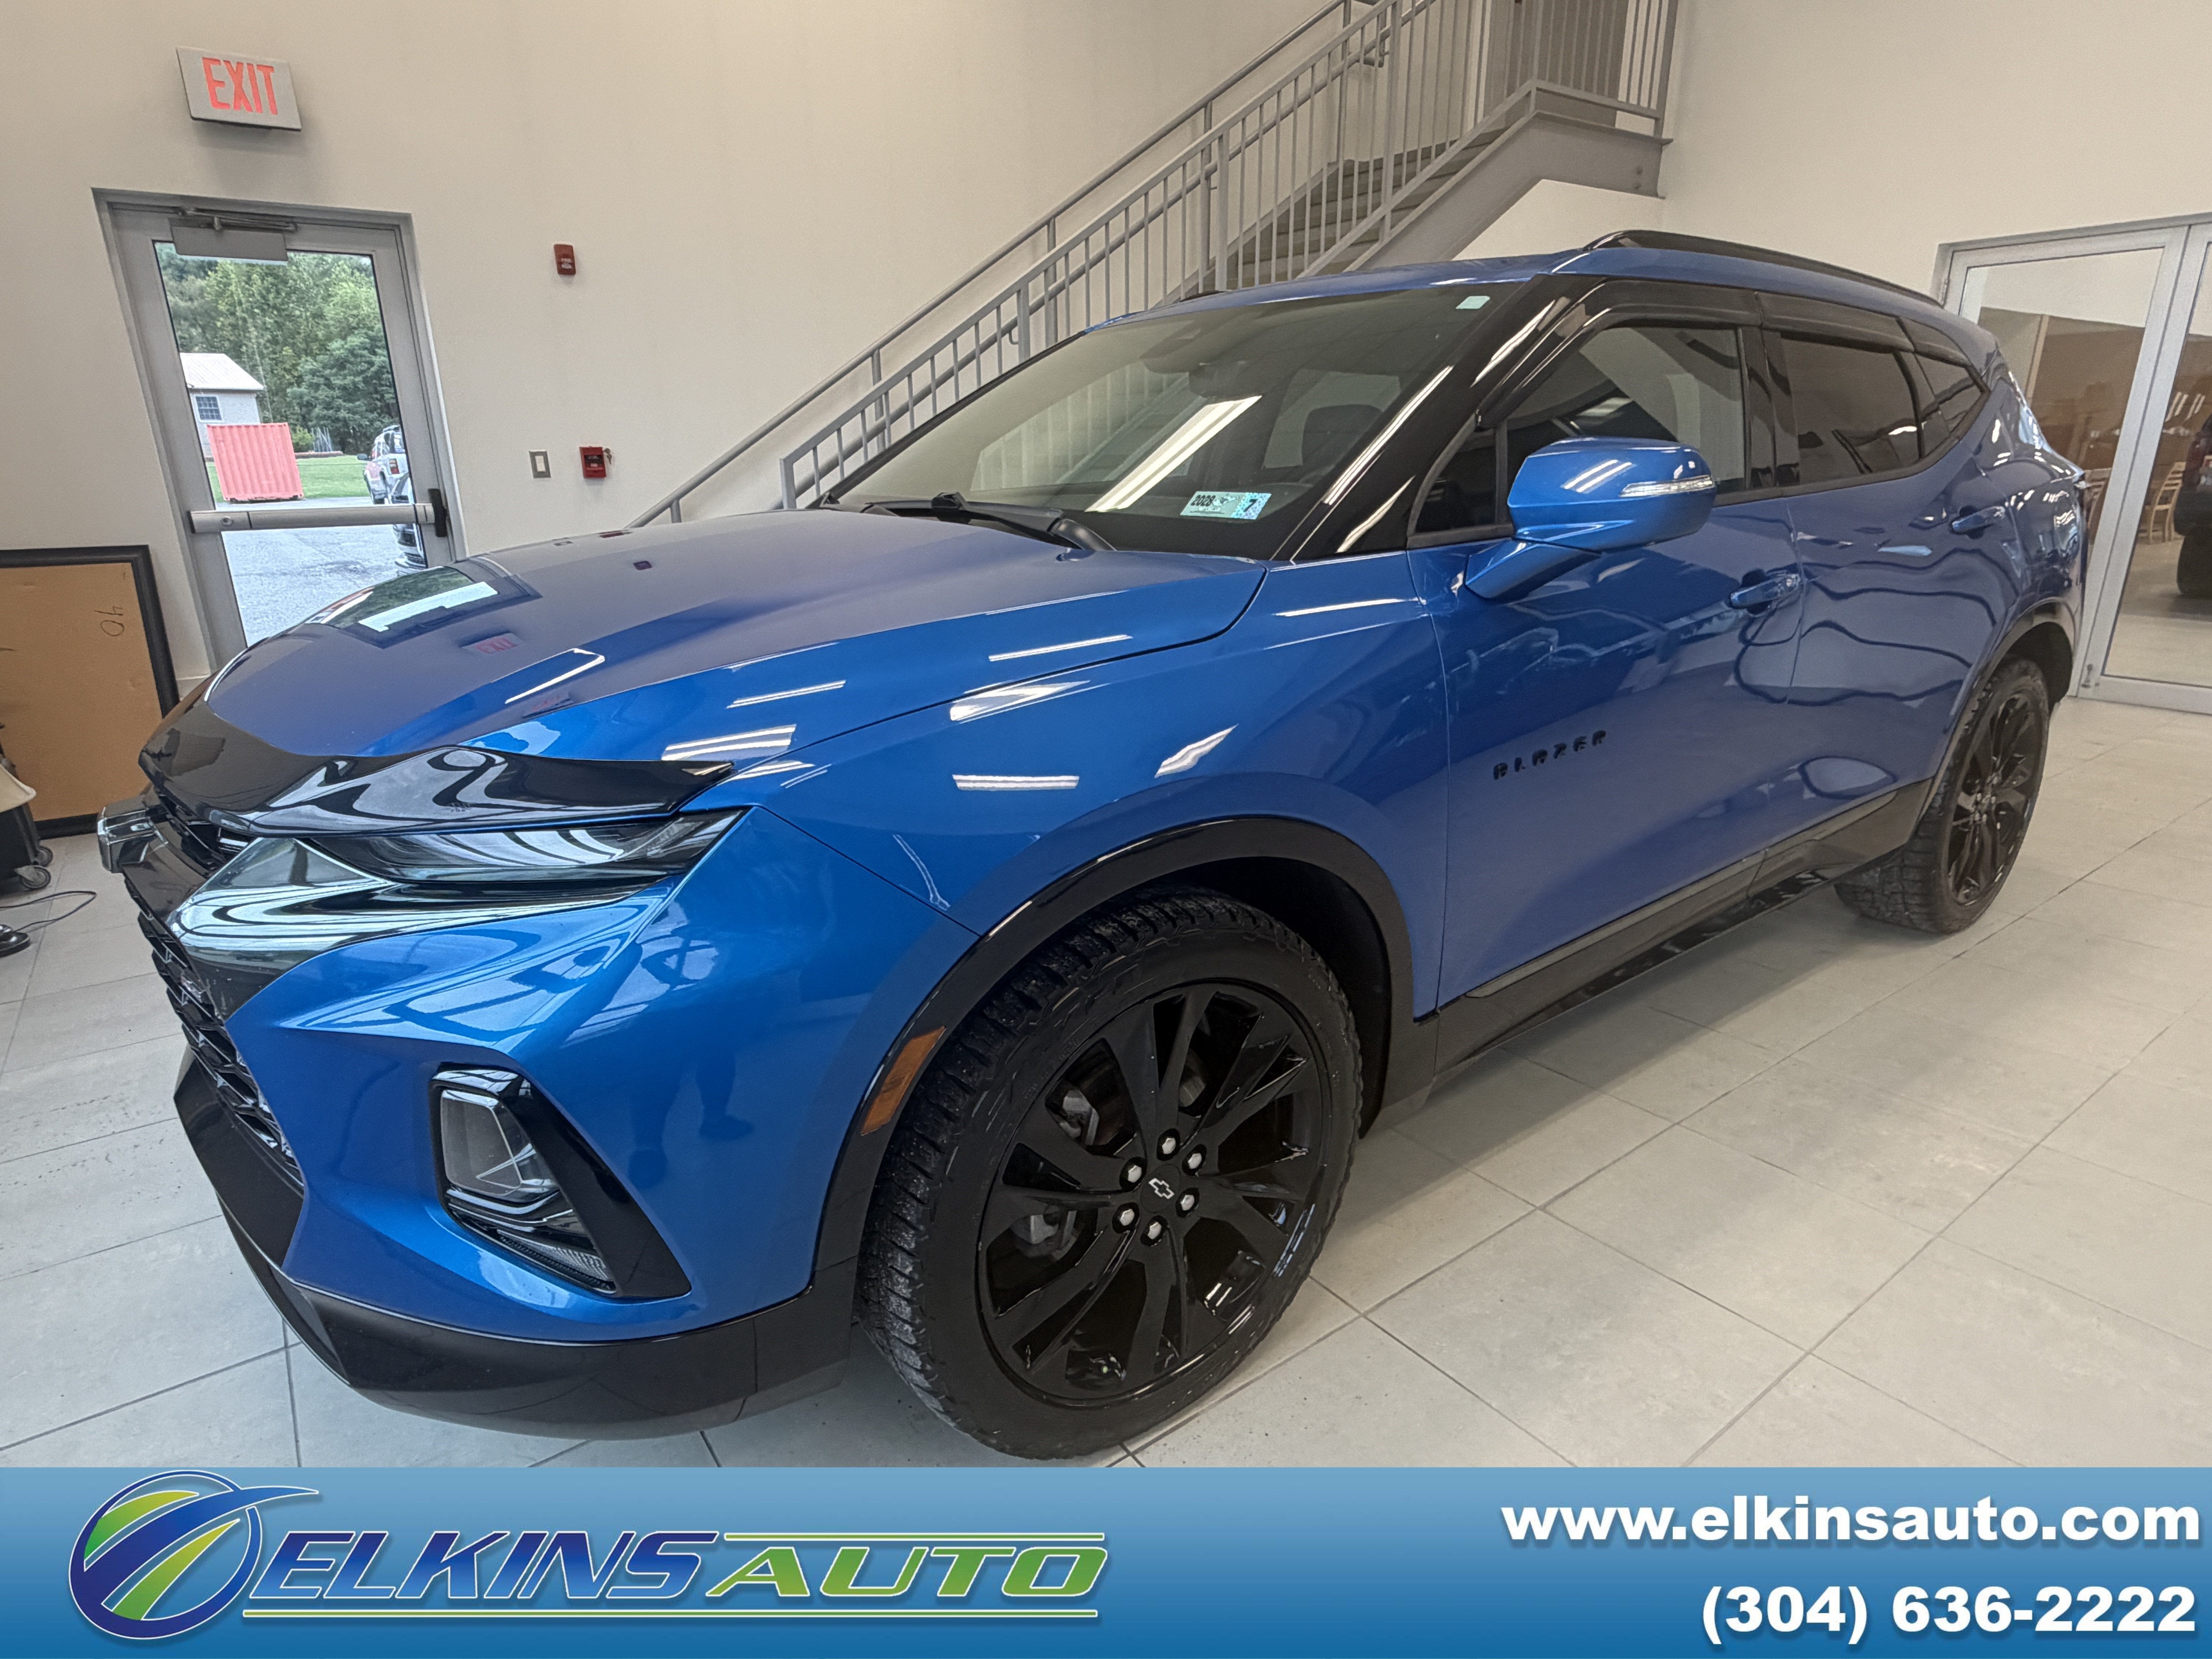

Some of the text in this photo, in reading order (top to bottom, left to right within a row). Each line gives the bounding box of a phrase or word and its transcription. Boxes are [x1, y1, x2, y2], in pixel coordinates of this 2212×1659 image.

[202, 57, 277, 115] EXIT
[1190, 495, 1216, 507] 2028
[1243, 498, 1258, 512] 7
[1493, 730, 1606, 780] BLAZER
